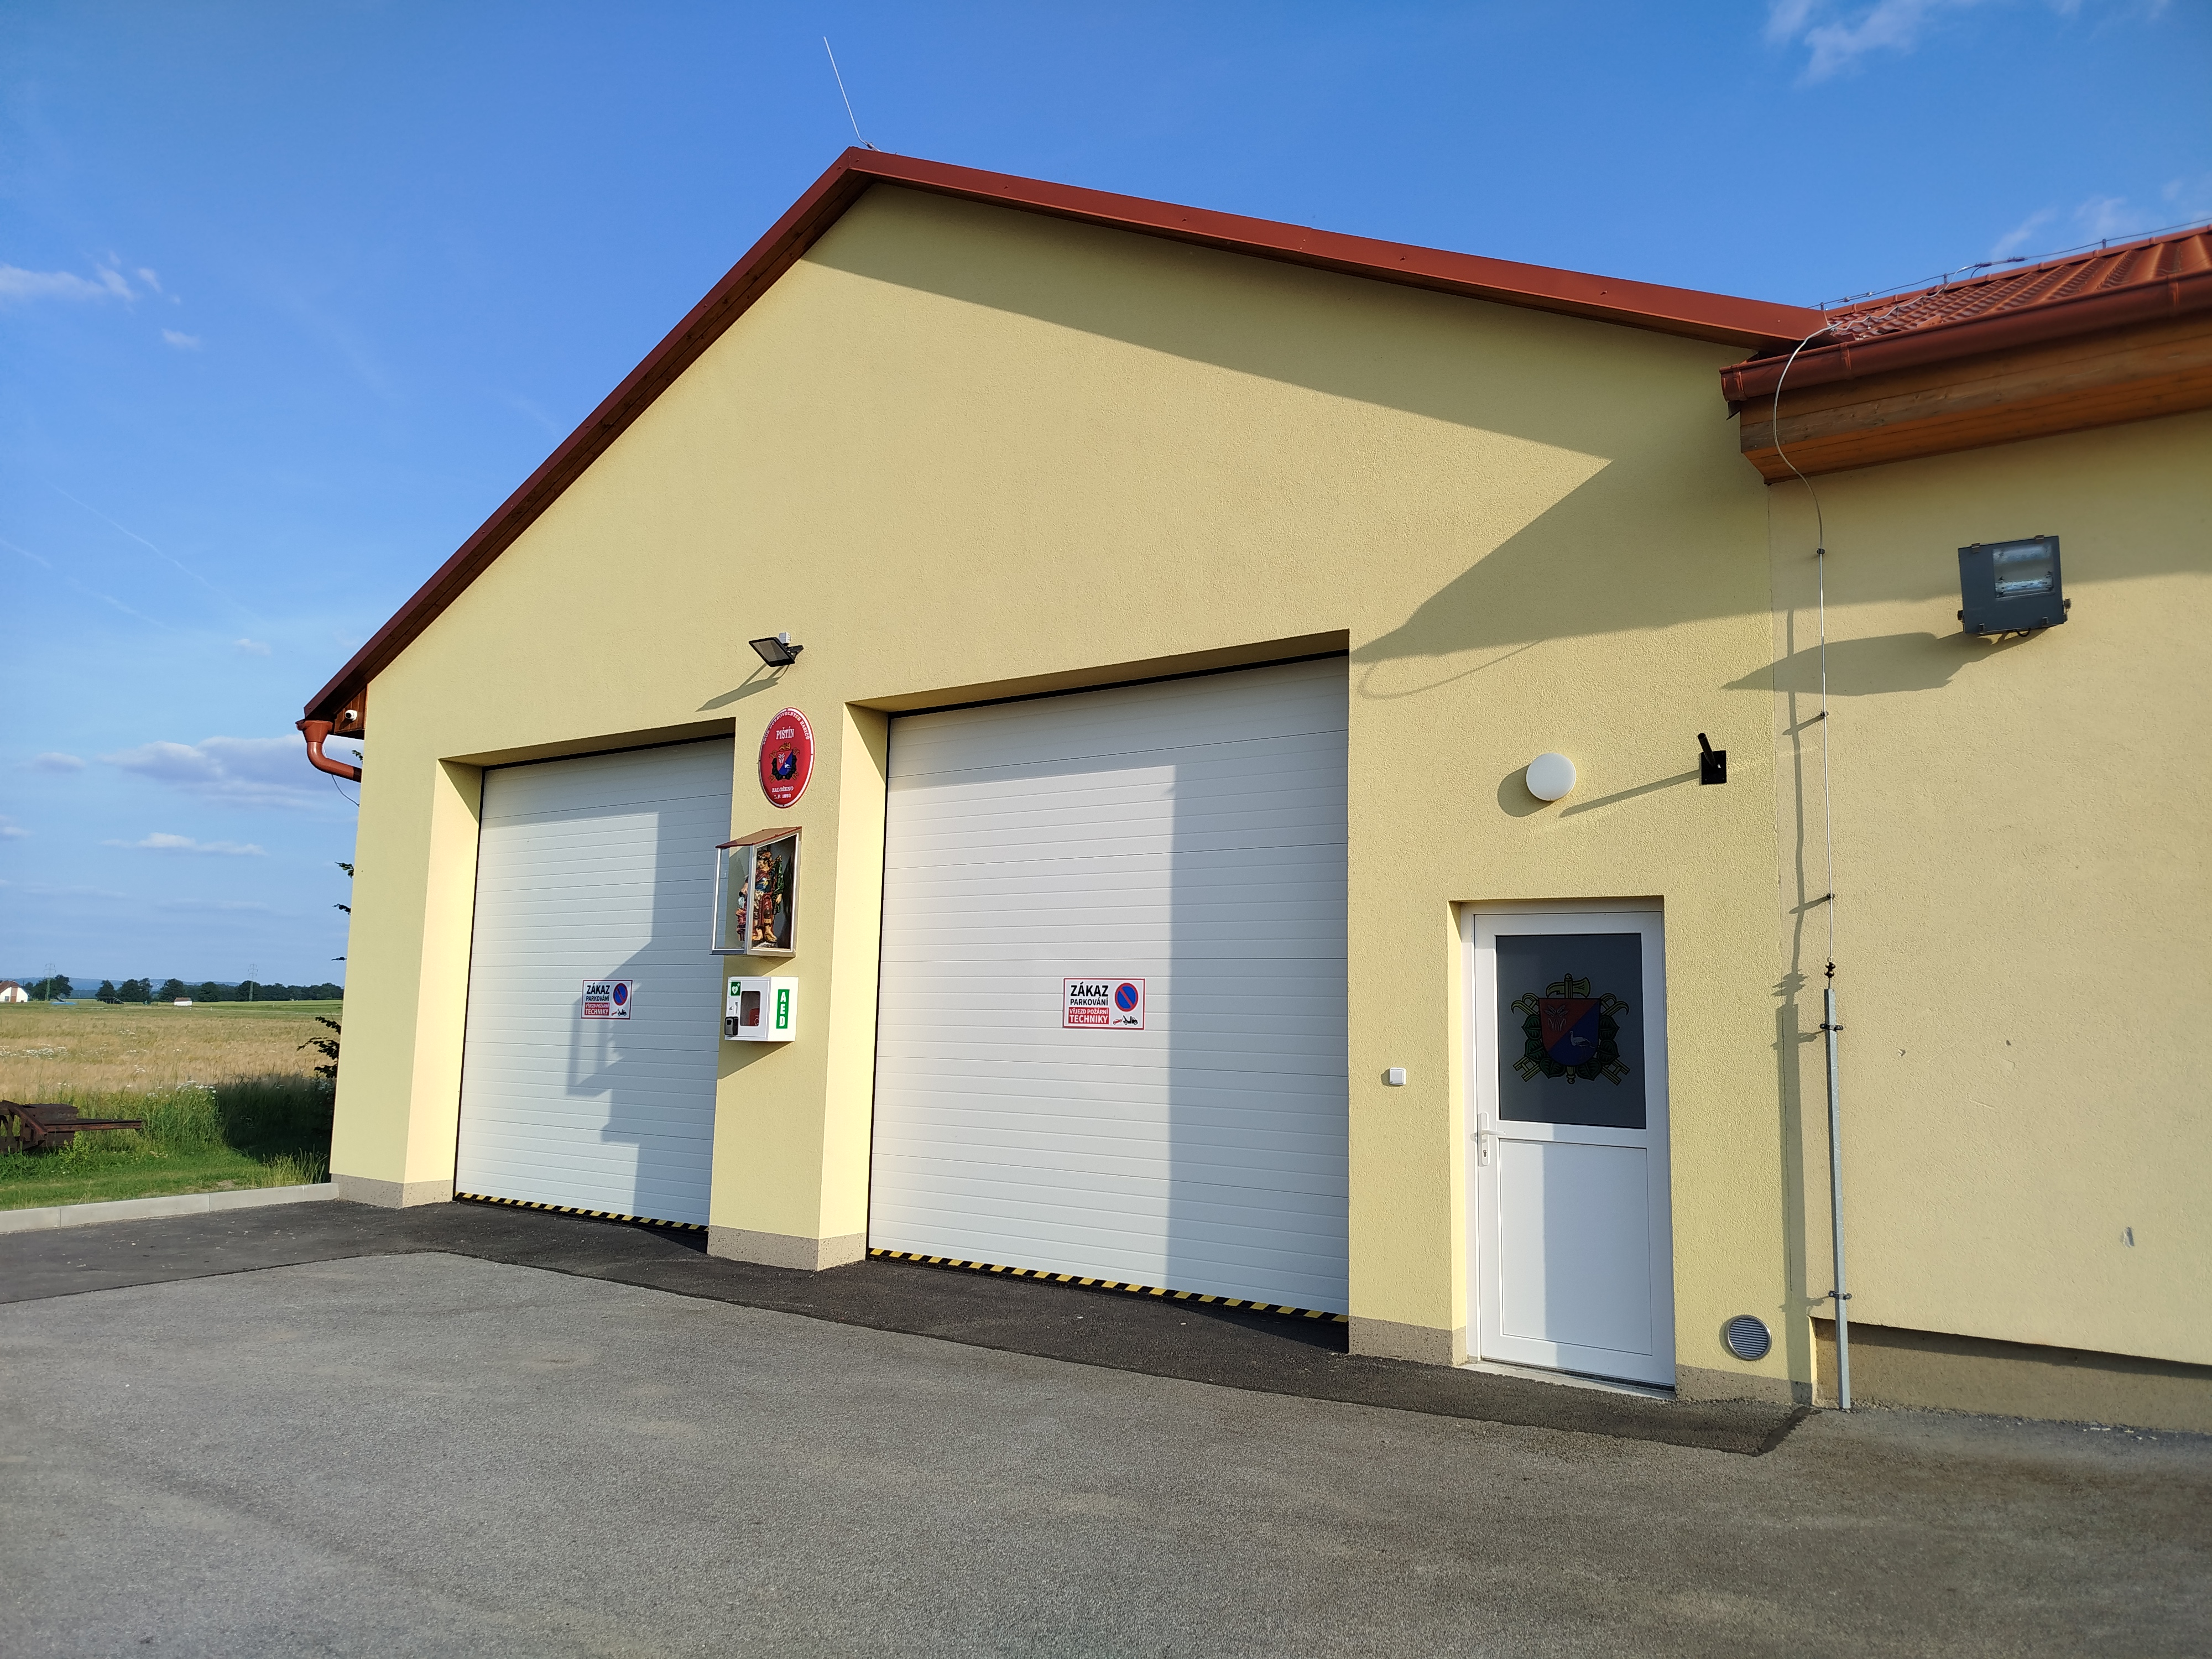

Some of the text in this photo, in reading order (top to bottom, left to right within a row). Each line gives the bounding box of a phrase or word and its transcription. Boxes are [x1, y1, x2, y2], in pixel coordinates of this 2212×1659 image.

[775, 726, 795, 740] PIŠTÍN
[586, 982, 611, 994] ZÁKAZ
[1070, 981, 1109, 997] ZÁKAZ
[1070, 997, 1109, 1006] PARKOVÁNÍ
[1069, 1014, 1108, 1024] TECHNIKY
